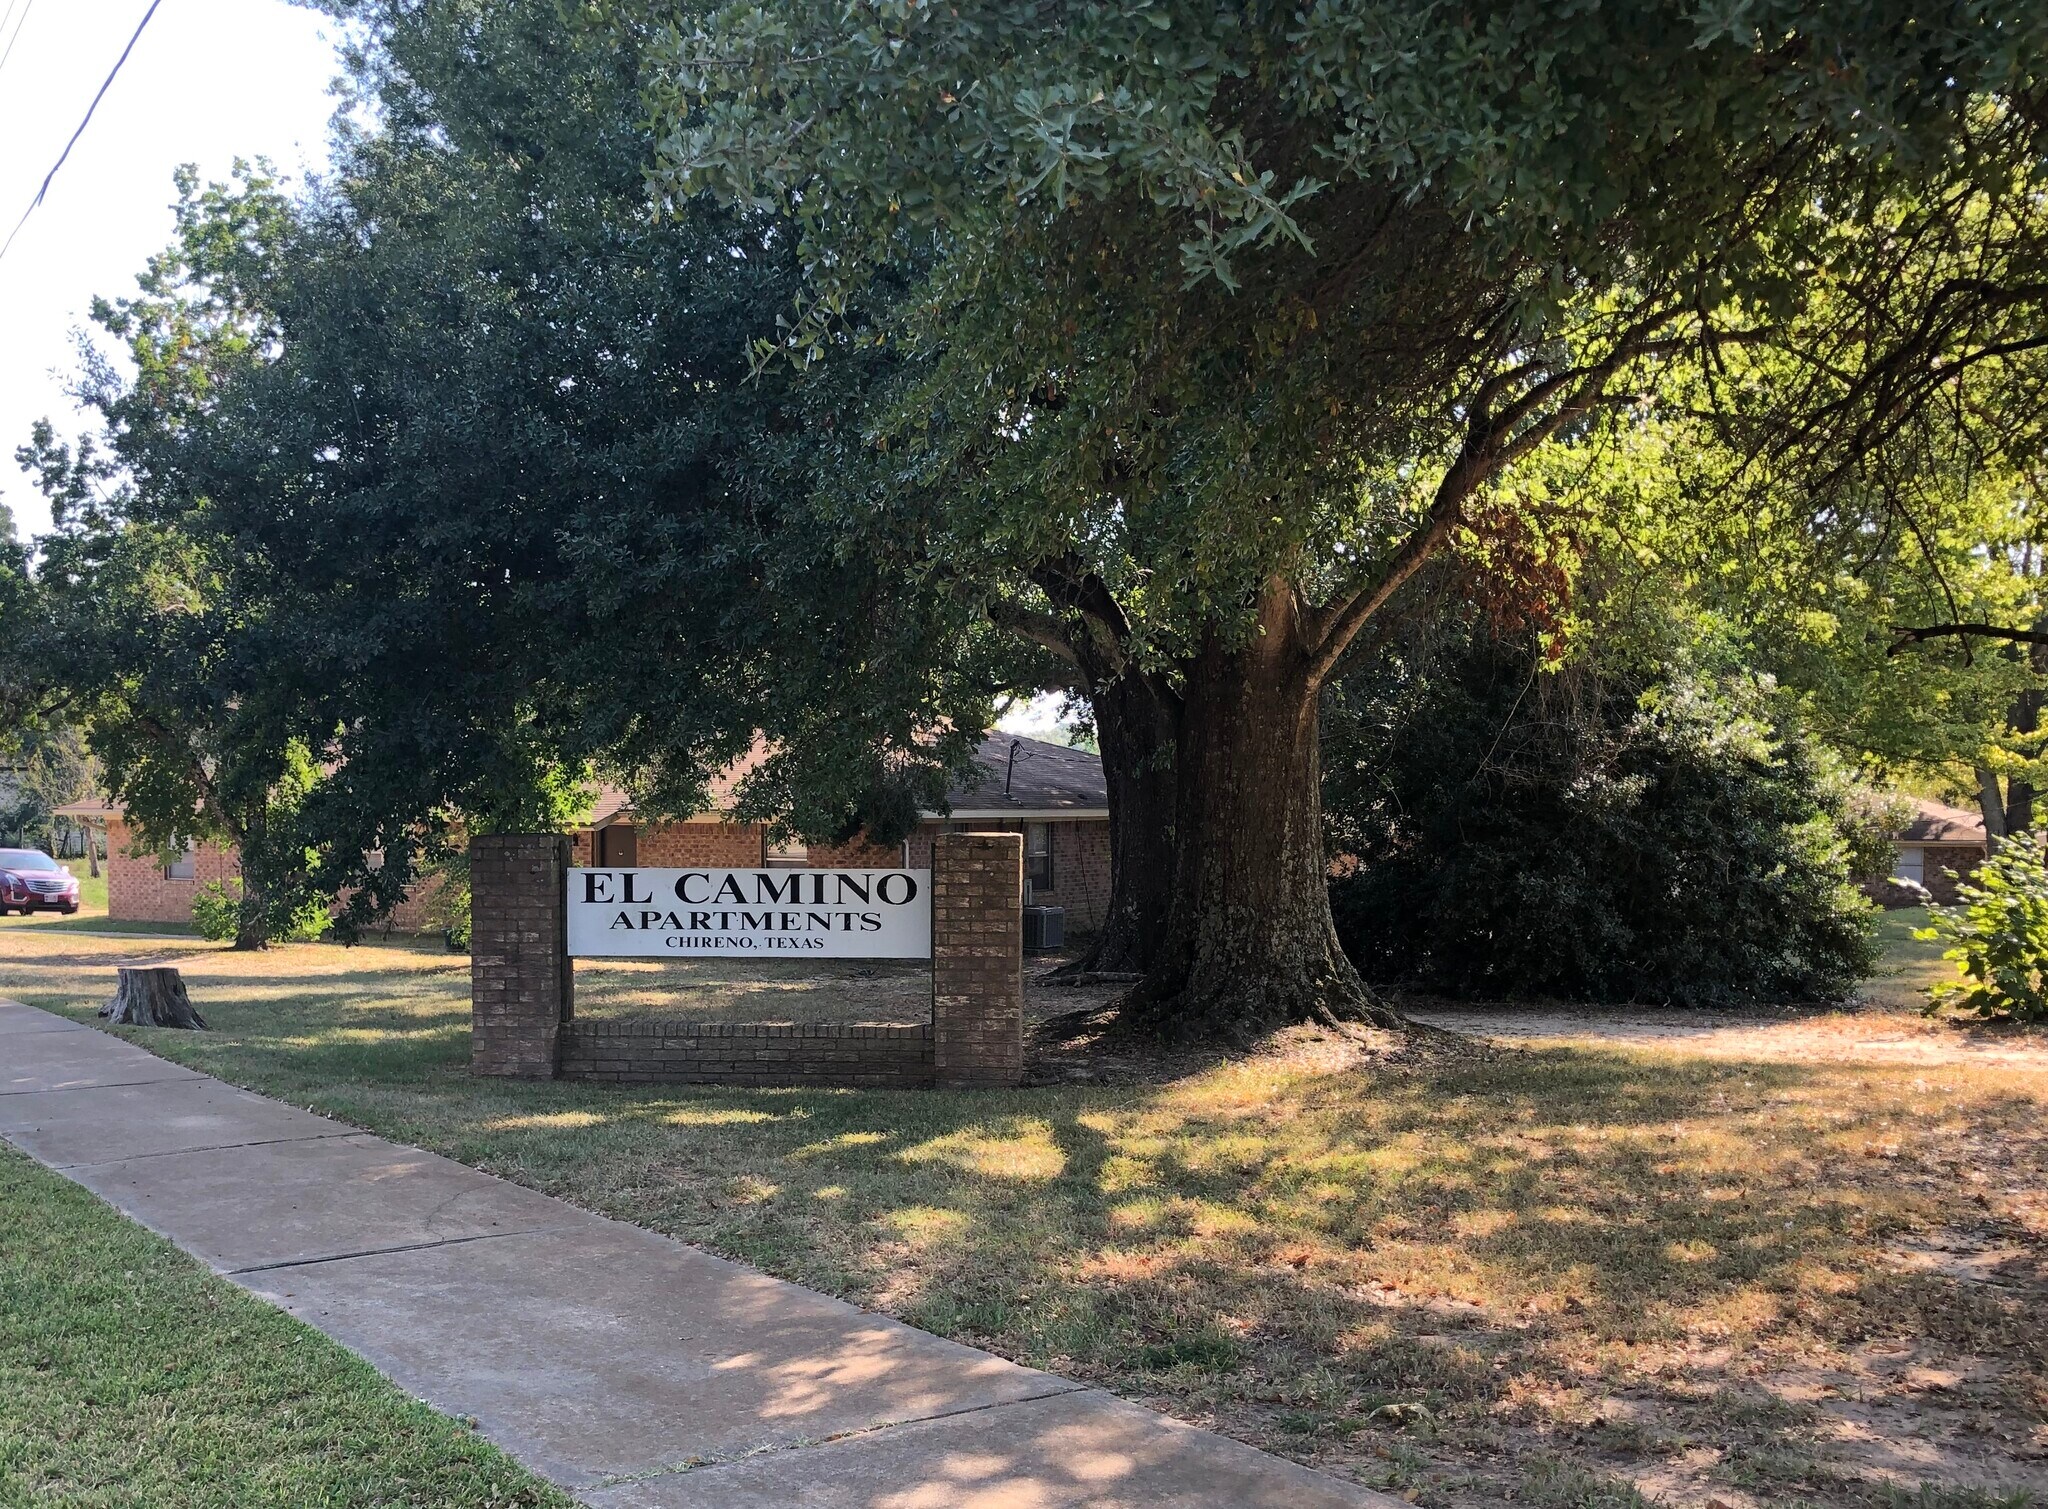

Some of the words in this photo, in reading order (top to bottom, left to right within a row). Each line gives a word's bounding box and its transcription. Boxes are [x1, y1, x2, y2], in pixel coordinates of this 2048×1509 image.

[580, 872, 654, 904] EL
[674, 872, 918, 906] CAMINO
[608, 910, 883, 932] APARTMENTS
[665, 936, 759, 950] CHIRENO,
[766, 936, 825, 950] TEXAS
